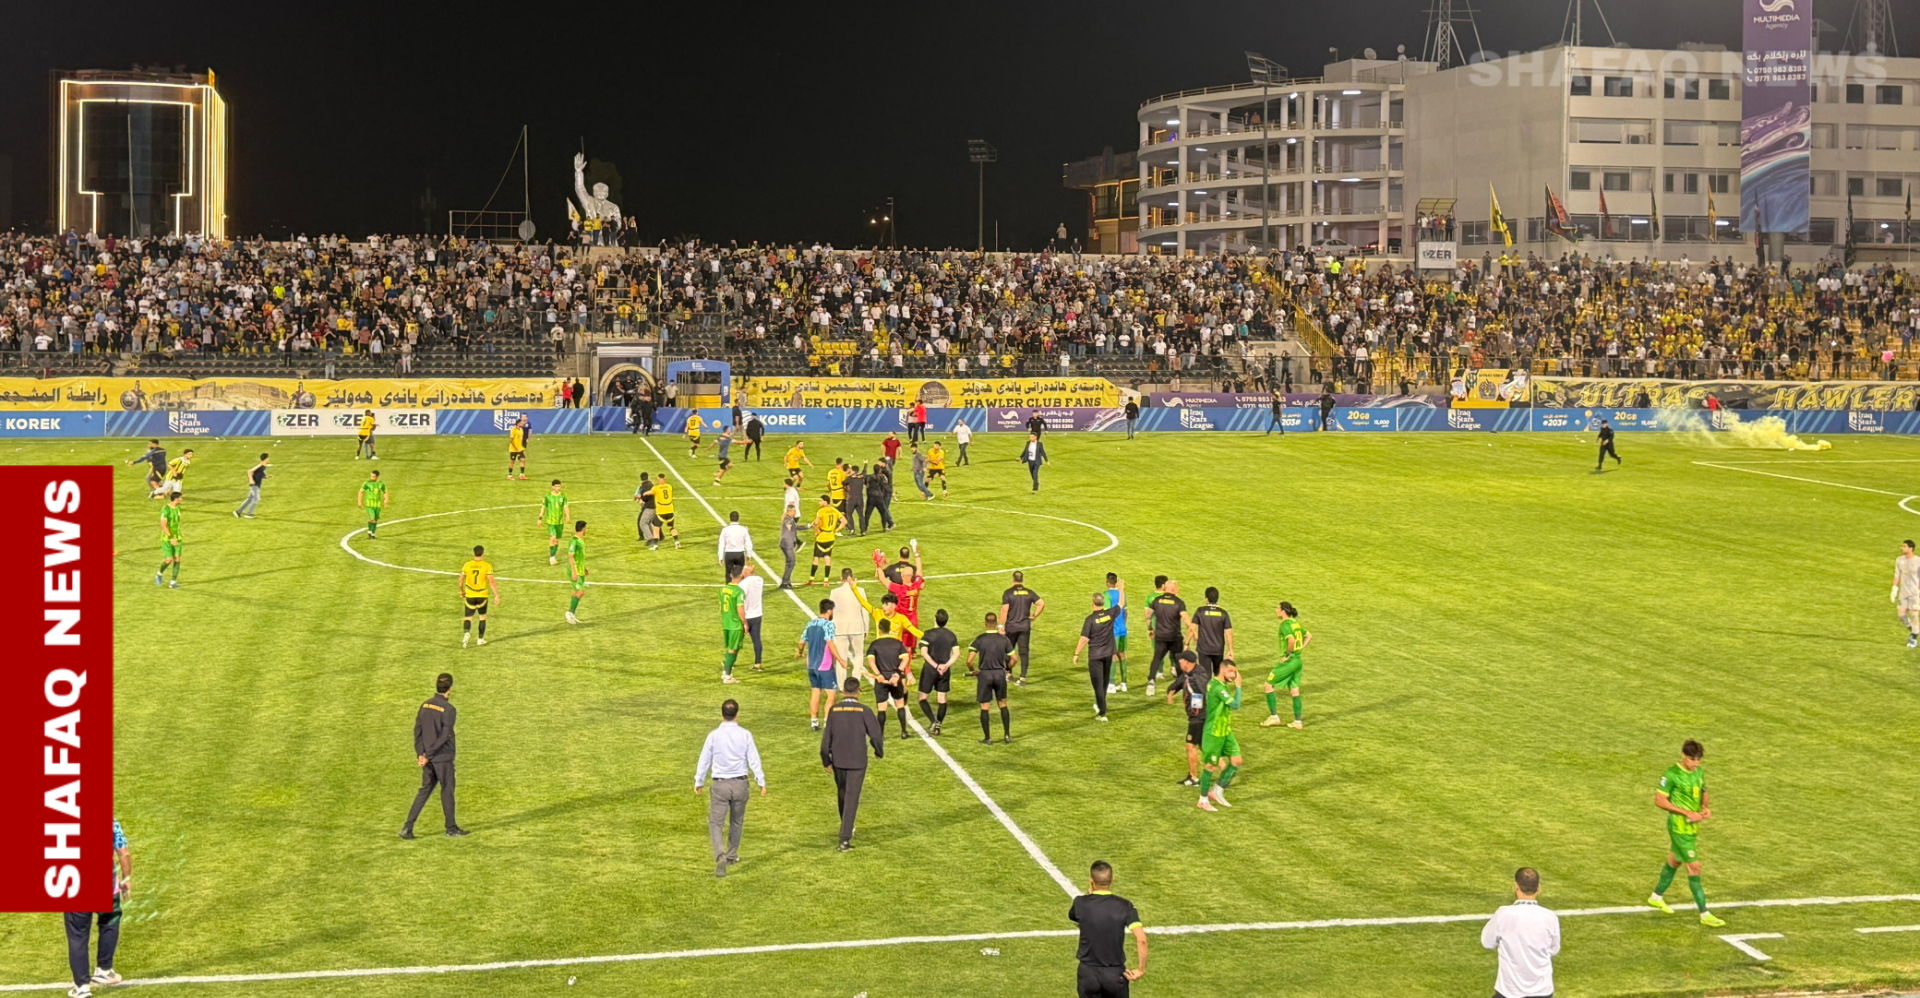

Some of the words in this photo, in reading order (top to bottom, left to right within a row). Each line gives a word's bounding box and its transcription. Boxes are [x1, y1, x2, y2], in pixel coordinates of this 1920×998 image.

[1753, 14, 1800, 23] MULTIMEDIA
[761, 397, 822, 408] HAWER
[826, 398, 862, 408] CLUB
[866, 399, 905, 408] FANS
[964, 398, 1023, 408] HAWLER
[1026, 398, 1062, 408] CLUB
[1065, 397, 1102, 408] FANS
[1767, 386, 1916, 411] HAWLER
[180, 411, 197, 421] Iraq
[504, 409, 520, 420] Iraq
[1190, 409, 1204, 417] Iraq
[1347, 411, 1359, 420] 20
[1457, 409, 1471, 418] Iraq
[1614, 411, 1626, 420] 20
[1858, 411, 1872, 420] Iraq
[5, 418, 61, 430] KOREK
[286, 414, 319, 426] ZER
[398, 413, 430, 426] ZER
[759, 414, 807, 426] KOREK
[180, 426, 210, 435] League
[1190, 422, 1214, 430] League
[1457, 422, 1481, 430] League
[1858, 424, 1884, 432] League
[472, 570, 480, 585] 7
